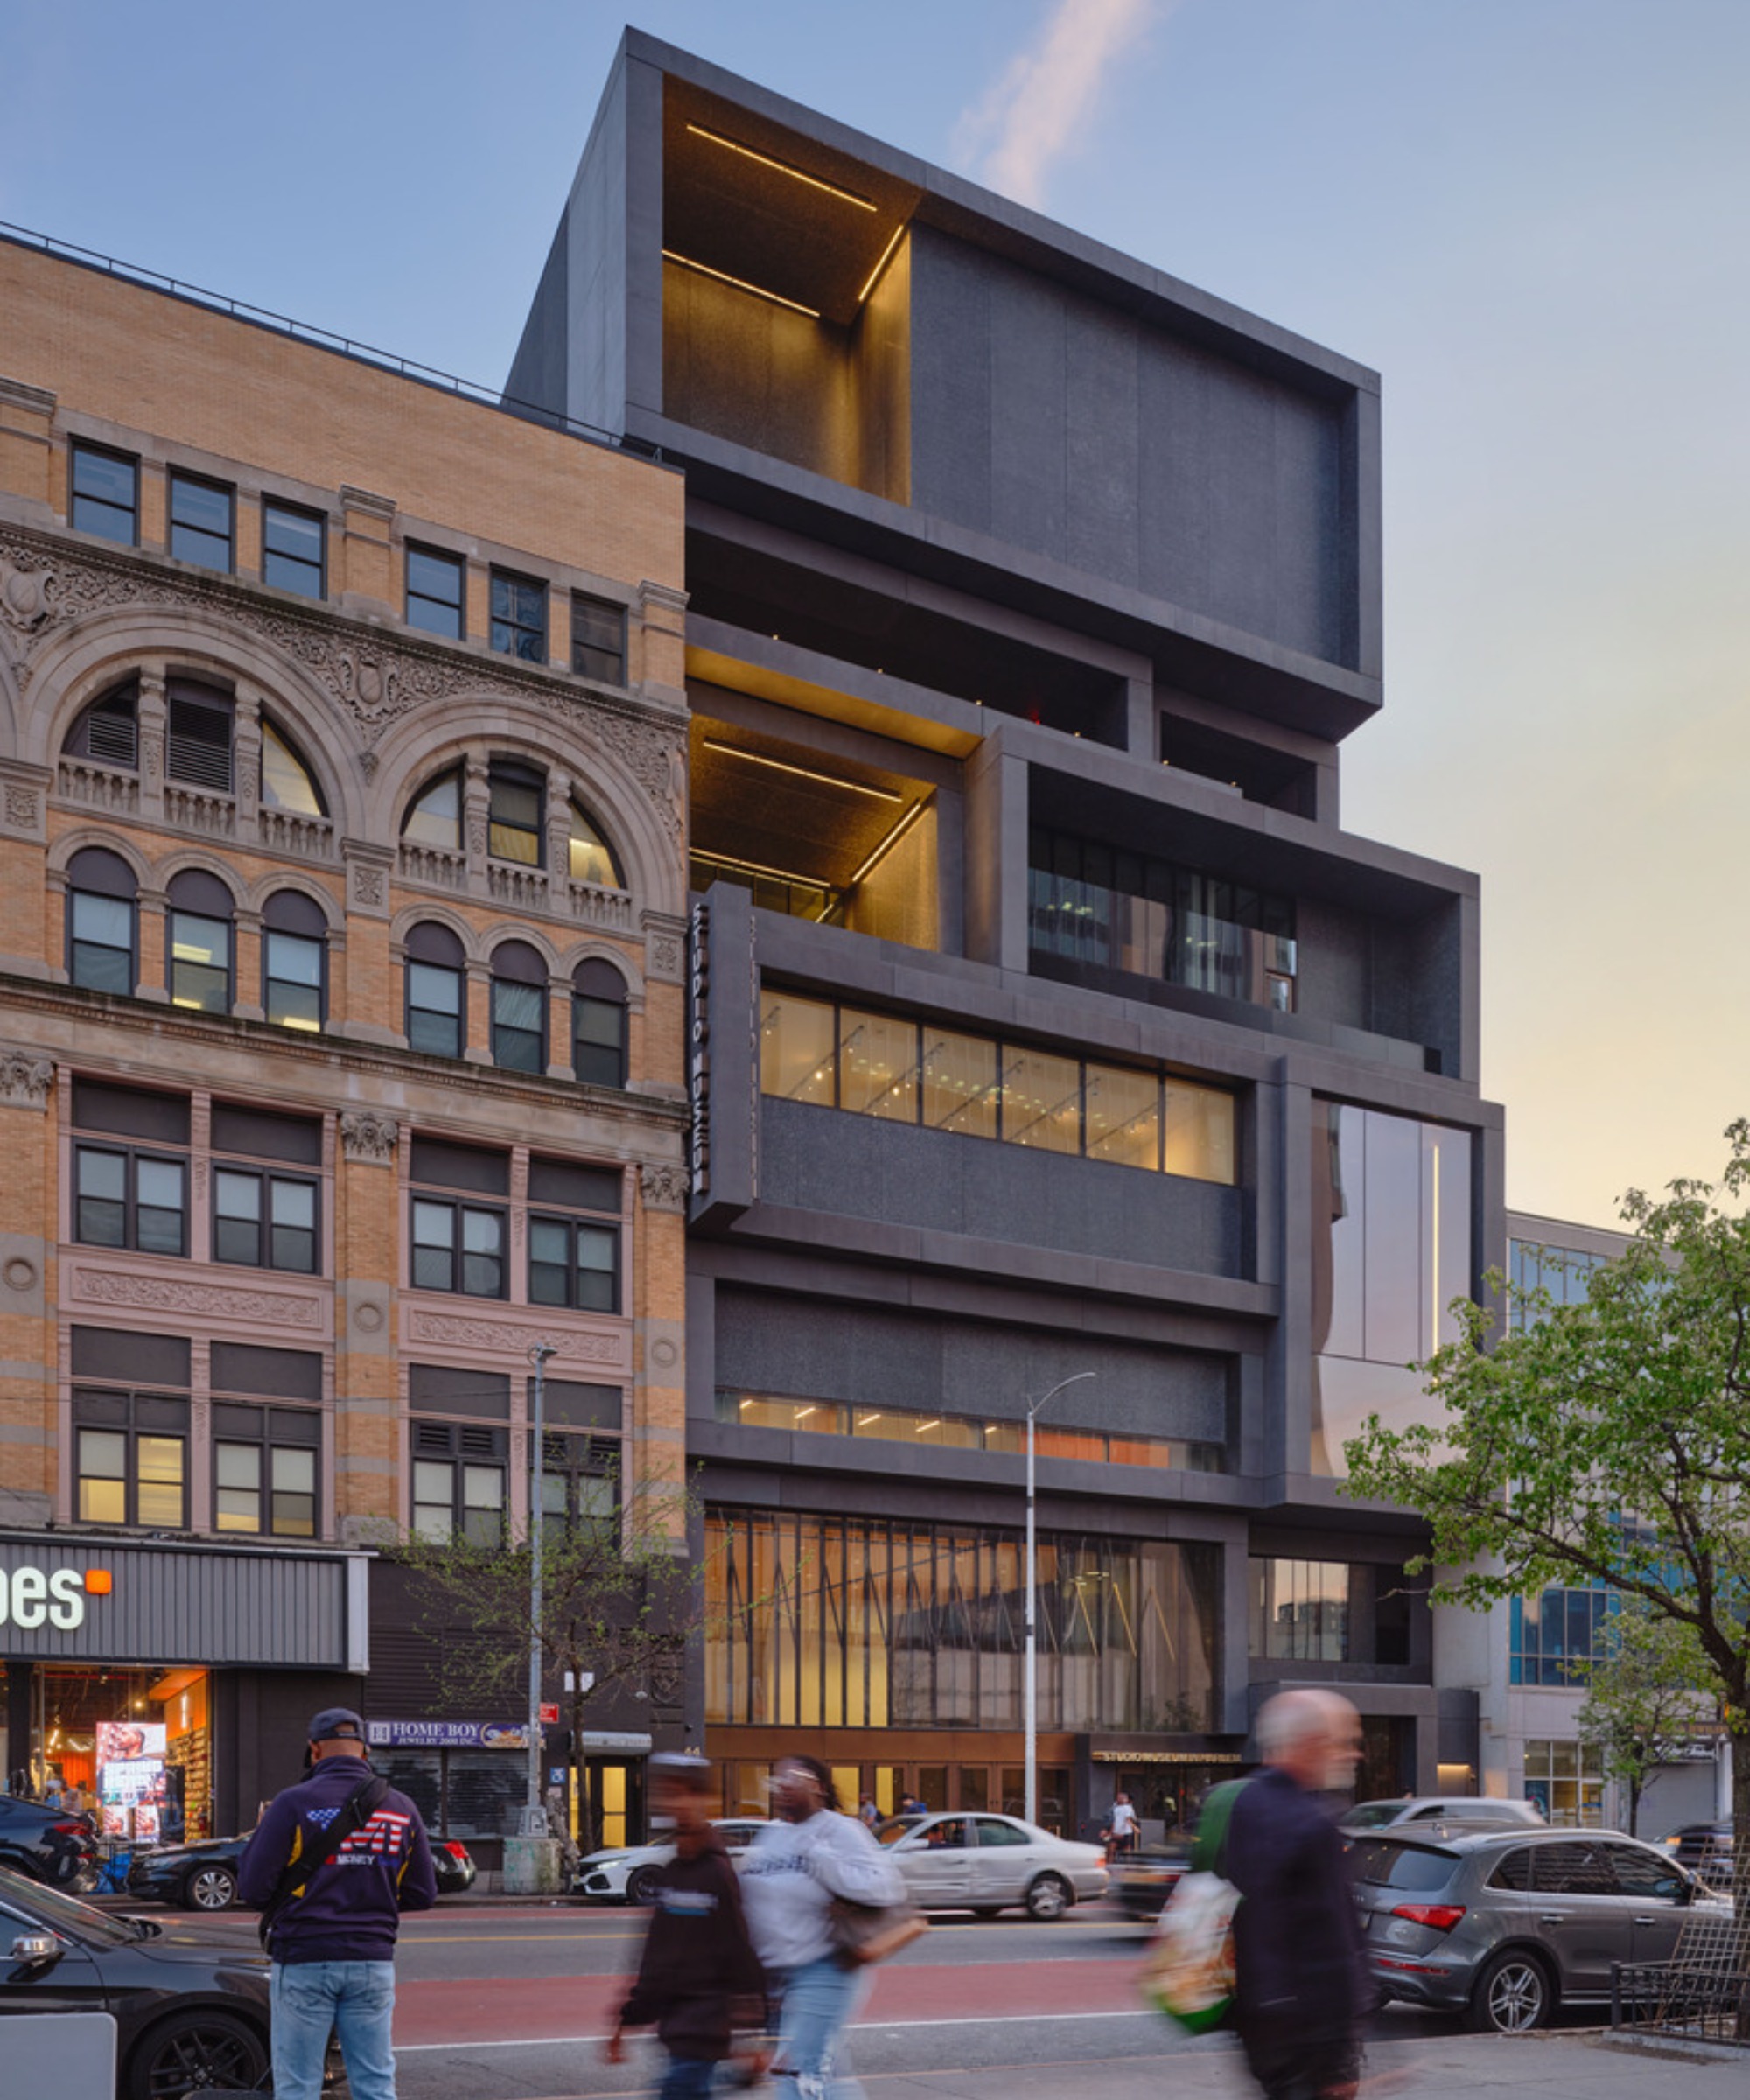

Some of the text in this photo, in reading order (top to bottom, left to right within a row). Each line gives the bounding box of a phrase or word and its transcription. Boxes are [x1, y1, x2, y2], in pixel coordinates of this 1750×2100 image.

[692, 903, 706, 1194] STUDIO MUSEUM
[0, 1566, 84, 1629] es
[393, 1722, 444, 1737] HOME
[448, 1723, 480, 1738] BOY
[337, 1854, 374, 1865] MONEY
